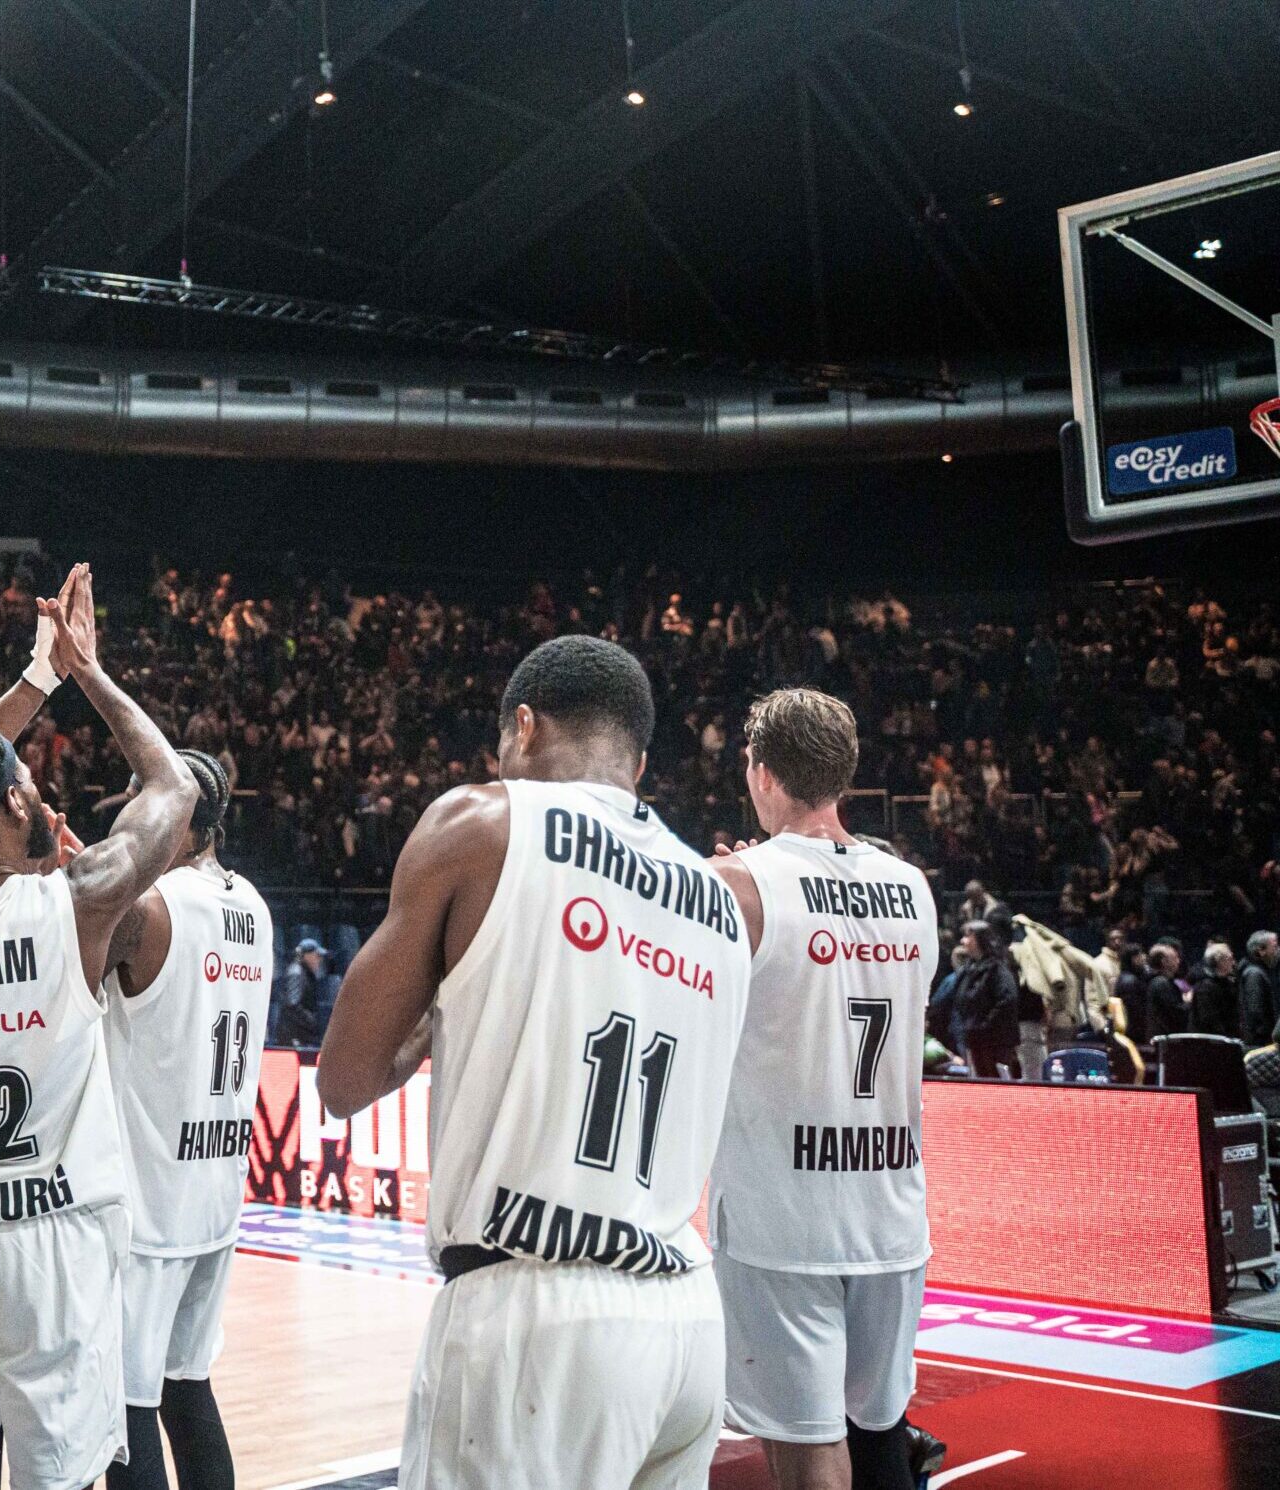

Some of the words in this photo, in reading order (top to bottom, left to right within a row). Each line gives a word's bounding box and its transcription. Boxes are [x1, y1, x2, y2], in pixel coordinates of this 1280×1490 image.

[1148, 453, 1227, 484] Credit
[545, 807, 738, 943] CHRISTMAS
[799, 876, 918, 920] MEISNER
[222, 908, 255, 946] KING
[225, 962, 262, 982] VEOLIA
[618, 925, 714, 1000] VEOLIA
[841, 941, 920, 962] VEOLIA
[210, 1011, 248, 1096] 13
[847, 997, 892, 1099] 7
[574, 1011, 677, 1189] 11
[300, 1169, 430, 1210] BASKE
